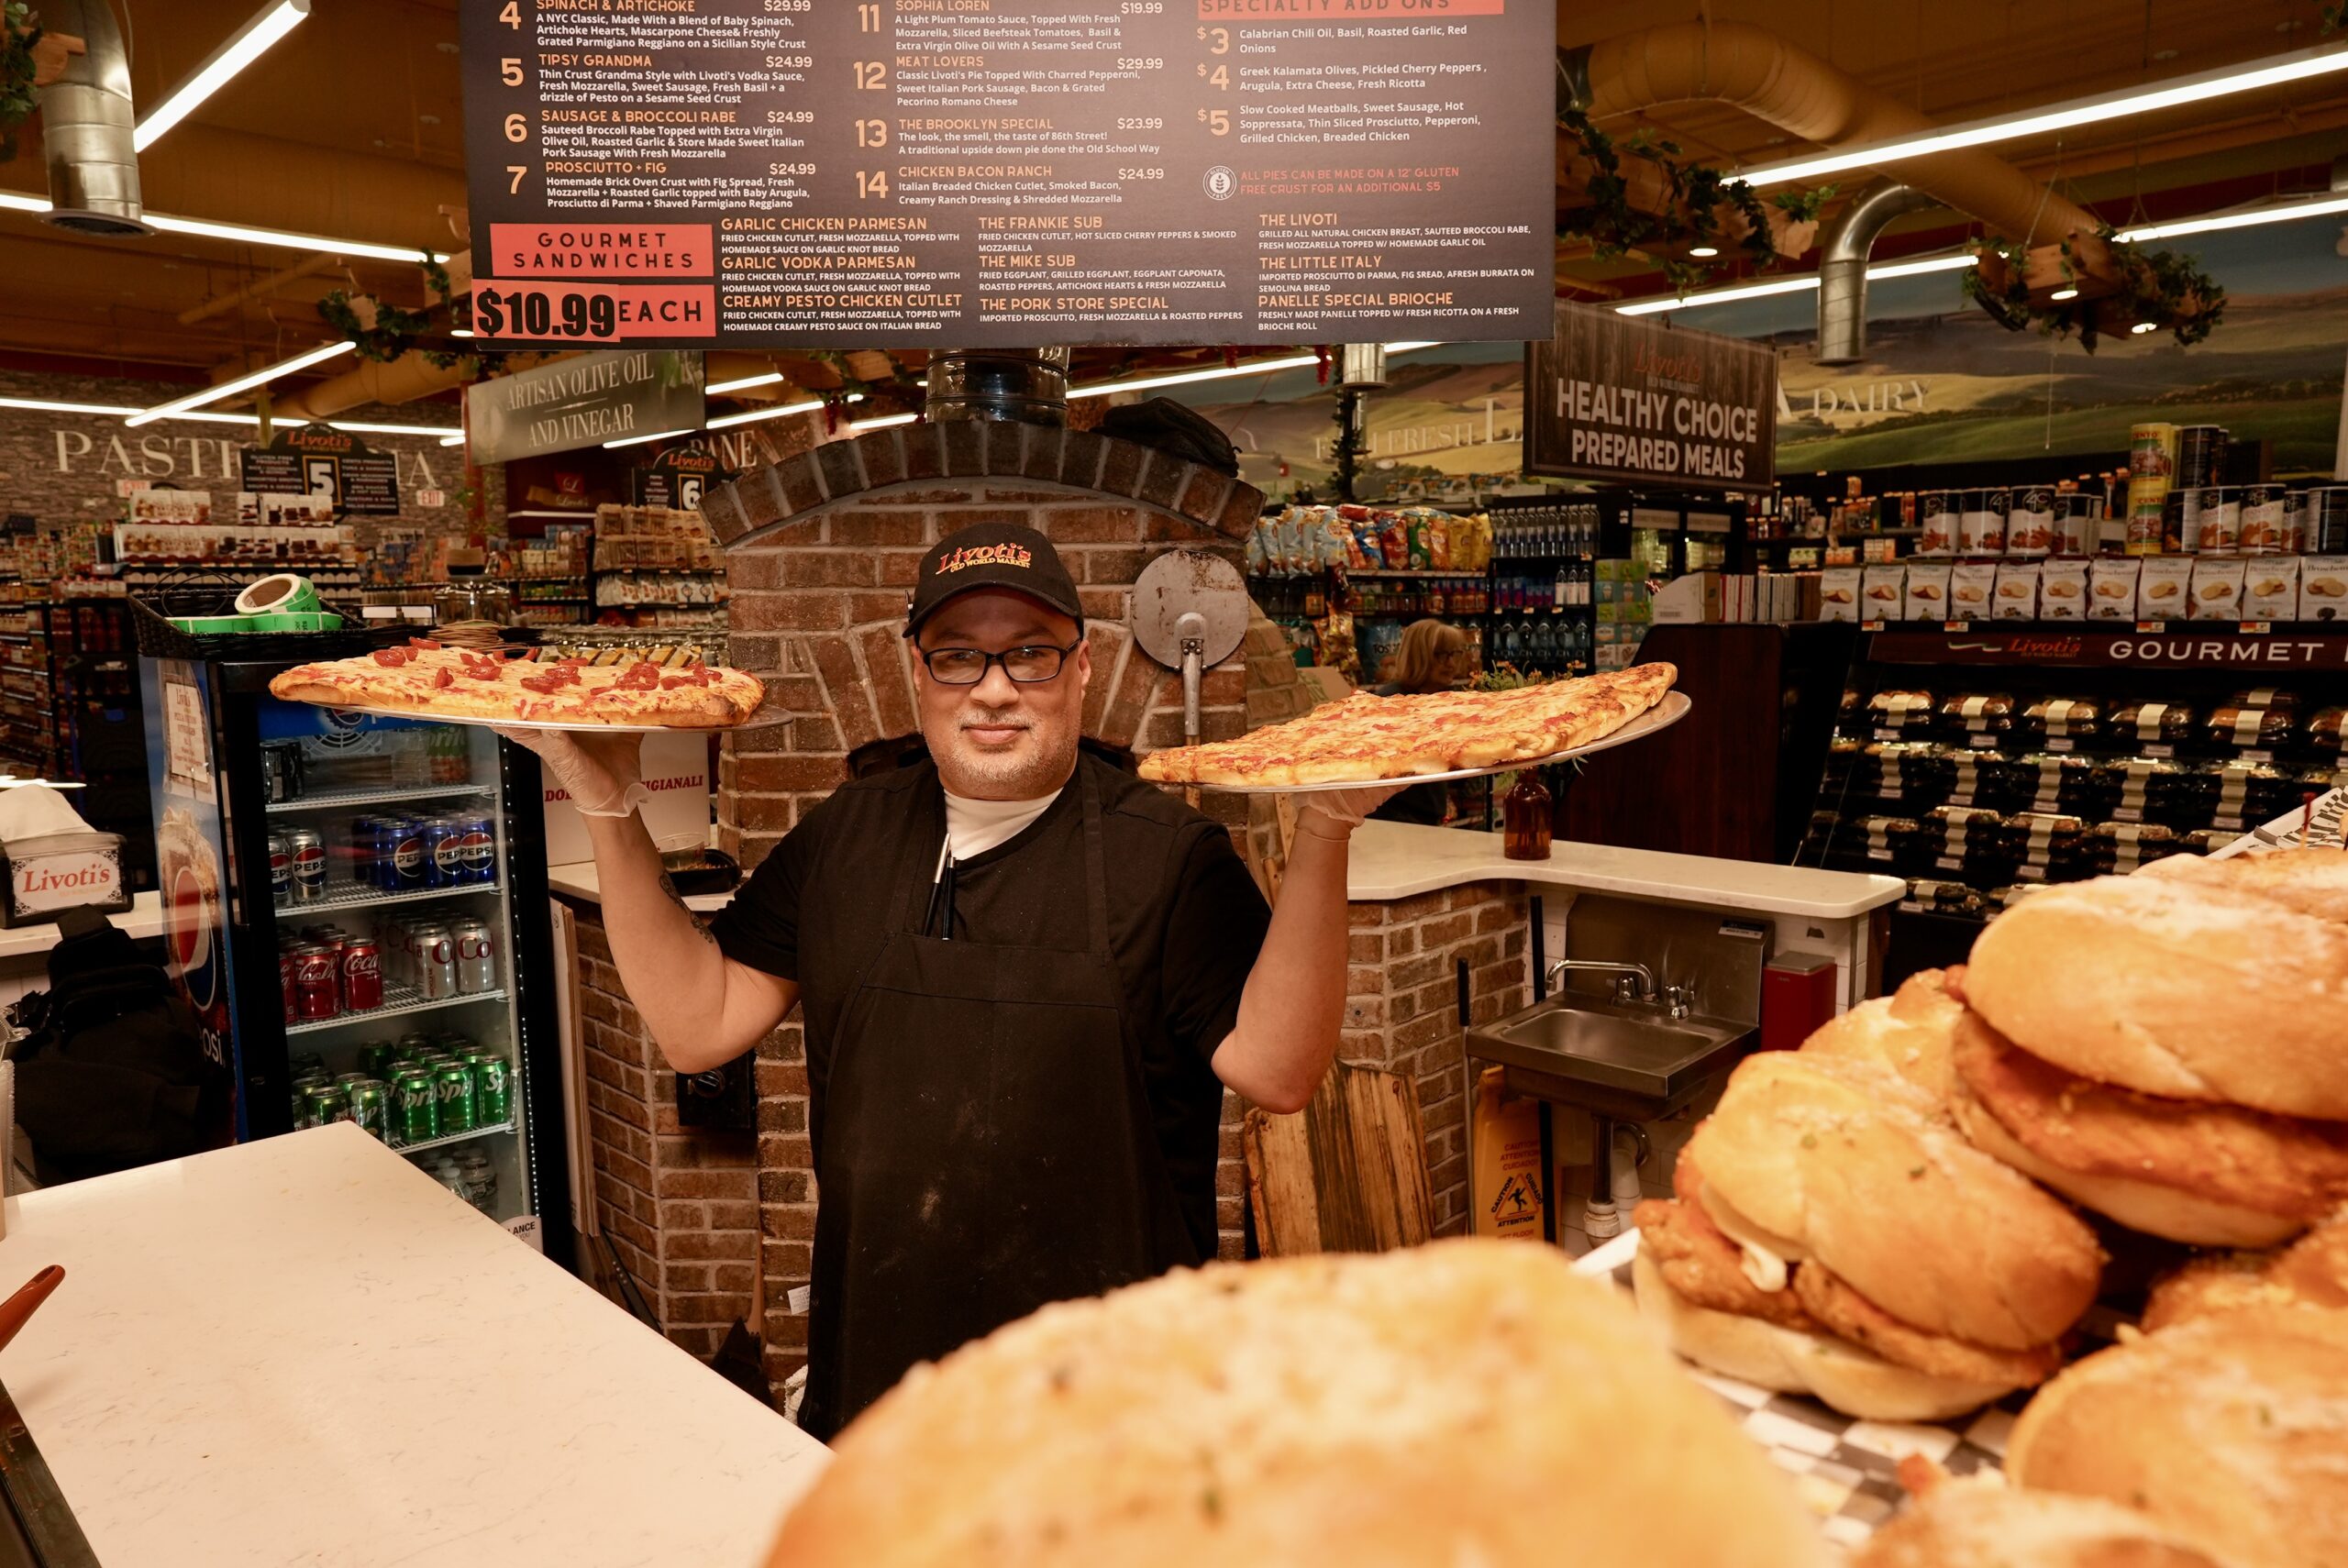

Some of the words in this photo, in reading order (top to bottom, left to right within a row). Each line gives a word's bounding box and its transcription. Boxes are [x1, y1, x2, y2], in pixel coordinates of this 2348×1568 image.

[537, 0, 597, 10] SPINACH
[603, 0, 611, 10] &
[617, 0, 694, 11] ARTICHOKE
[765, 0, 811, 11] $29.99
[896, 0, 943, 10] SOPHIA
[948, 1, 989, 10] LOREN
[1122, 2, 1162, 14] $19.99
[1202, 0, 1329, 12] SPECIALTY
[1345, 0, 1388, 10] ADD
[1401, 0, 1448, 9] ONS
[500, 2, 521, 29] 4
[858, 5, 879, 31] 11
[1240, 29, 1289, 39] Calabrian
[1292, 28, 1313, 38] Chili
[1317, 28, 1334, 38] Oil,
[1338, 28, 1364, 38] Basil,
[1368, 27, 1409, 36] Roasted
[1412, 26, 1445, 36] Garlic,
[1448, 25, 1467, 34] Red
[1197, 27, 1229, 54] $3
[1240, 44, 1276, 52] Onions
[539, 54, 578, 65] TIPSY
[584, 55, 651, 66] GRANDMA
[767, 56, 812, 68] $24.99
[897, 57, 929, 66] MEAT
[934, 56, 983, 66] LOVERS
[1118, 58, 1163, 70] $29.99
[502, 59, 523, 86] 5
[854, 62, 886, 89] 12
[1198, 63, 1229, 91] $4
[542, 110, 607, 121] SAUSAGE
[612, 111, 621, 122] &
[626, 111, 696, 122] BROCCOLI
[702, 112, 736, 122] RABE
[768, 111, 814, 123] $24.99
[1198, 108, 1230, 136] $5
[505, 114, 526, 142] 6
[899, 119, 922, 129] THE
[926, 119, 996, 129] BROOKLYN
[1002, 119, 1053, 128] SPECIAL
[1118, 117, 1162, 129] $23.99
[856, 119, 887, 147] 13
[547, 162, 632, 172] PROSCIUTTO
[646, 162, 666, 172] FIG
[770, 163, 815, 175] $24.99
[899, 167, 954, 177] CHICKEN
[958, 166, 1003, 176] BACON
[1008, 166, 1051, 176] RANCH
[507, 166, 526, 193] 7
[1119, 168, 1164, 180] $24.99
[1241, 171, 1260, 180] ALL
[1262, 171, 1289, 181] PIES
[1292, 171, 1315, 180] CAN
[1318, 170, 1332, 180] BE
[1335, 170, 1365, 179] MADE
[1368, 169, 1385, 177] ON
[1415, 167, 1459, 177] GLUTEN
[857, 171, 888, 198] 14
[1271, 184, 1306, 193] CRUST
[1313, 184, 1334, 193] FOR
[1357, 182, 1421, 192] ADDITIONAL
[722, 218, 775, 230] GARLIC
[781, 218, 843, 229] CHICKEN
[849, 218, 925, 229] PARMESAN
[979, 217, 1005, 228] THE
[1010, 217, 1069, 228] FRANKIE
[1074, 216, 1102, 227] SUB
[1259, 215, 1285, 226] THE
[1290, 214, 1336, 226] LIVOTI
[537, 232, 667, 248] GOURMET
[514, 253, 692, 268] SANDWICHES
[722, 257, 776, 269] GARLIC
[781, 257, 832, 268] VODKA
[837, 257, 914, 268] PARMESAN
[980, 256, 1005, 267] THE
[1011, 255, 1041, 267] MIKE
[1047, 255, 1075, 266] SUB
[1260, 258, 1286, 269] THE
[1291, 257, 1336, 268] LITTLE
[1342, 256, 1381, 268] ITALY
[724, 295, 781, 307] CREAMY
[787, 295, 835, 306] PESTO
[840, 295, 902, 306] CHICKEN
[908, 294, 961, 306] CUTLET
[980, 299, 1006, 310] THE
[1012, 298, 1051, 310] PORK
[1058, 298, 1104, 309] STORE
[1110, 297, 1168, 309] SPECIAL
[1259, 295, 1319, 306] PANELLE
[1325, 294, 1384, 305] SPECIAL
[1390, 293, 1453, 304] BRIOCHE
[476, 288, 615, 337] $10.99
[618, 301, 702, 322] EACH
[506, 371, 567, 410] ARTISAN
[570, 360, 620, 396] OLIVE
[624, 352, 654, 383] OIL
[1813, 379, 1932, 417] DAIRY
[1556, 377, 1668, 431] HEALTHY
[1674, 397, 1757, 443] CHOICE
[528, 419, 559, 448] AND
[561, 403, 635, 441] VINEGAR
[287, 430, 352, 447] Livoti's
[1388, 422, 1474, 453] FRESH
[1571, 428, 1679, 472] PREPARED
[1684, 444, 1744, 479] MEALS
[310, 462, 335, 496] 5
[422, 492, 441, 505] EXIT
[682, 480, 701, 511] 6
[936, 542, 1032, 575] Livoti's
[950, 562, 965, 573] OLD
[966, 557, 996, 567] WORLD
[997, 557, 1030, 569] MARKET
[2109, 640, 2324, 662] GOURMET
[460, 846, 493, 856] PEPSI
[23, 863, 110, 893] Livoti's
[1491, 1176, 1513, 1213] CAUTION
[1497, 1216, 1534, 1228] ATTENTION
